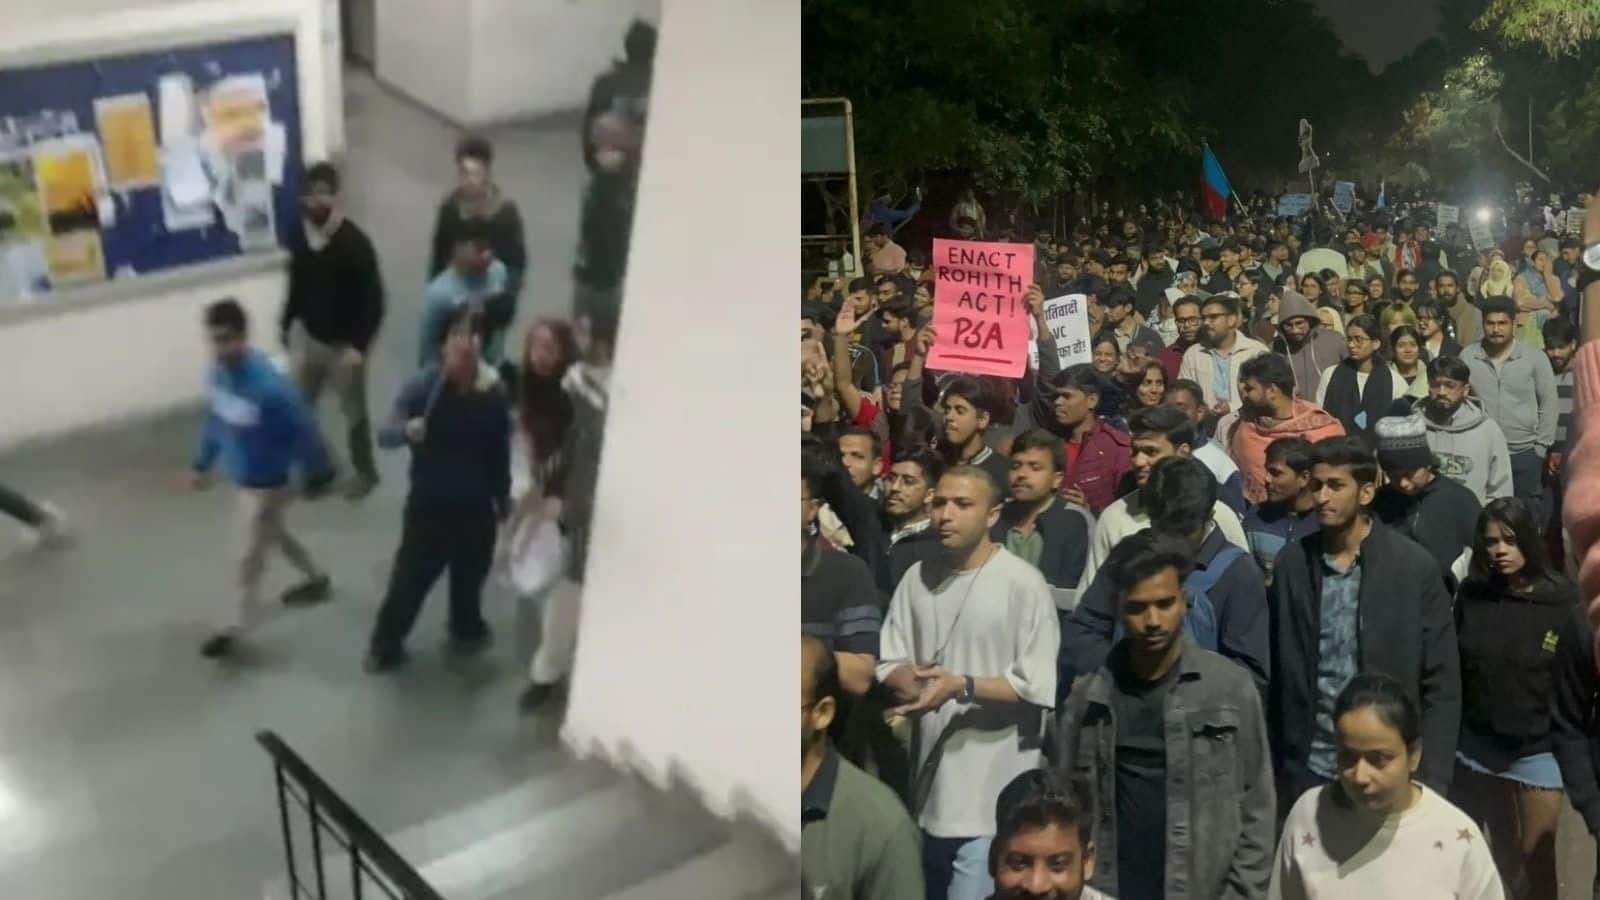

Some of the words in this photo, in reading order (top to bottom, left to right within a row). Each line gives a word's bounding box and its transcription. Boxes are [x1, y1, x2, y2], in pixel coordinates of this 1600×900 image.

[948, 247, 1016, 269] ENACT
[938, 265, 1022, 293] ROHITH
[958, 291, 1015, 318] ACT!
[1053, 326, 1067, 340] VC
